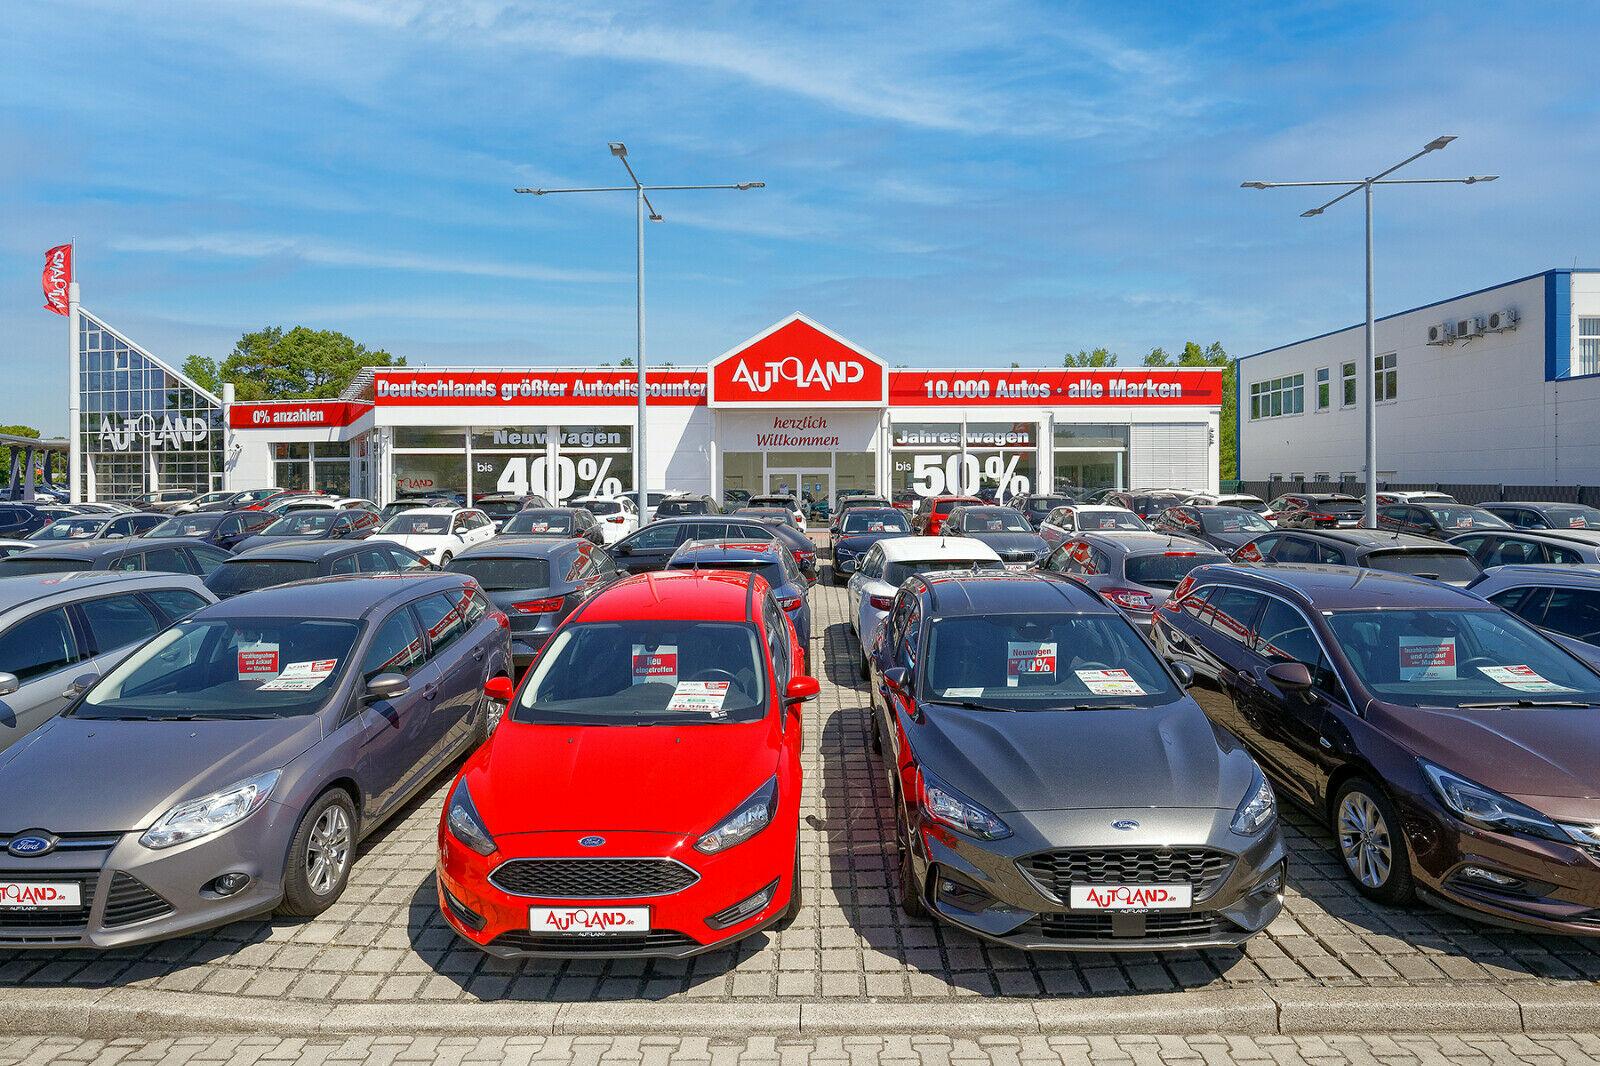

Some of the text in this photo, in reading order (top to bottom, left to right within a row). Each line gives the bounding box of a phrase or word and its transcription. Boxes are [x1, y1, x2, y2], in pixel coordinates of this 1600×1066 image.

[731, 356, 865, 392] AUTOLAND
[377, 379, 497, 397] Deutschlands
[501, 379, 568, 400] größter
[924, 379, 990, 398] 10.000
[995, 379, 1050, 398] Autos
[1068, 379, 1103, 398] alle
[1109, 379, 1182, 398] Marken
[252, 408, 324, 424] 0% anzahlen
[773, 416, 828, 430] herzlich
[757, 433, 839, 446] Willkommen
[477, 457, 622, 500] bis 40%
[895, 454, 1030, 499] bis 50%
[647, 657, 662, 665] Neu
[16, 839, 39, 850] Ford
